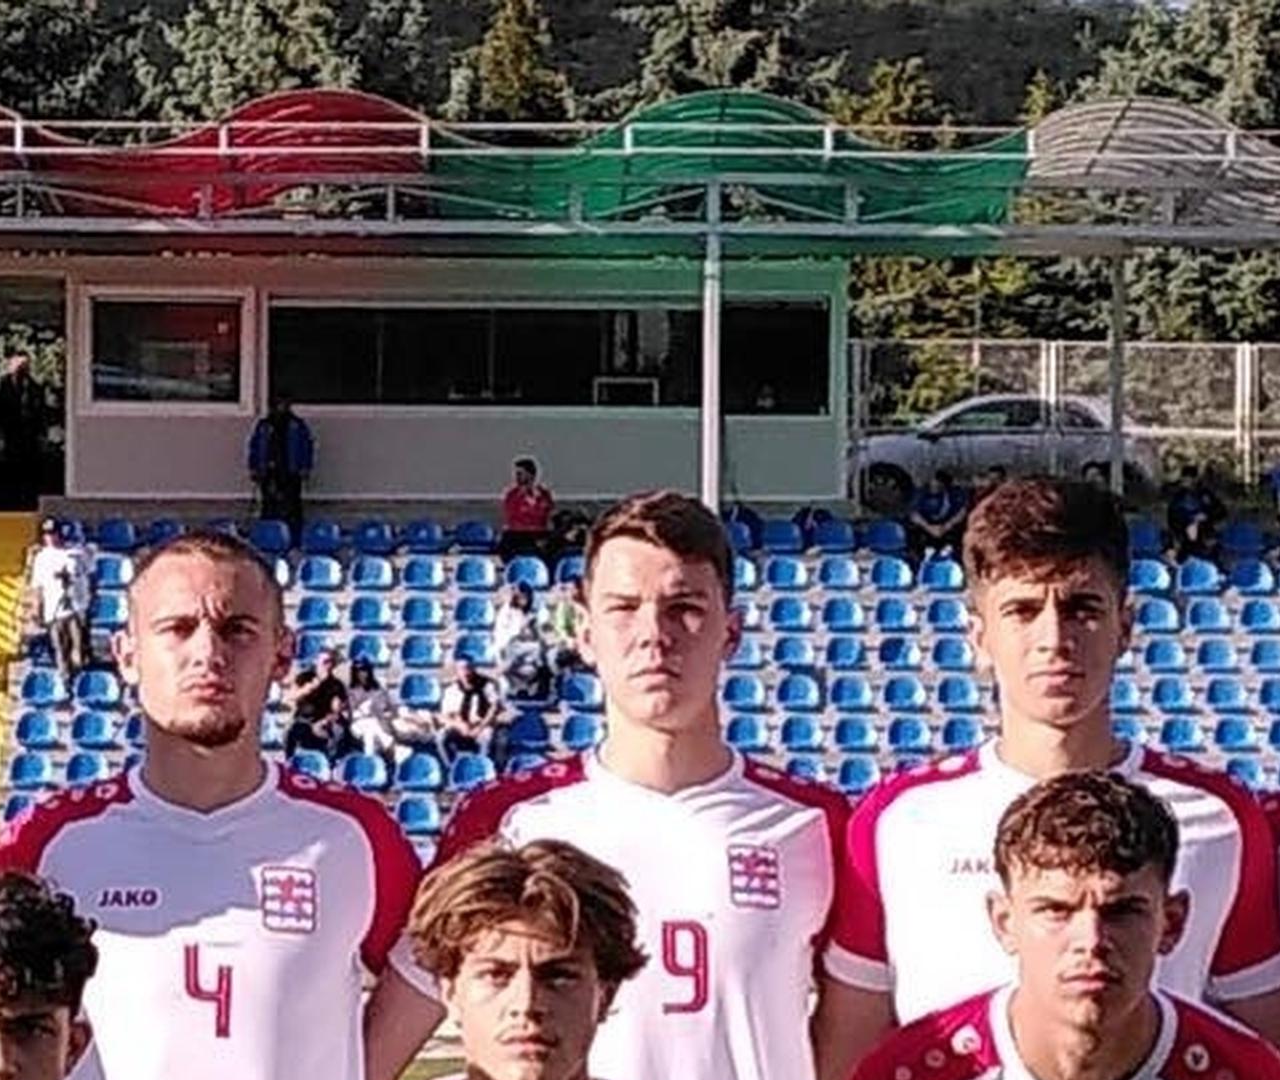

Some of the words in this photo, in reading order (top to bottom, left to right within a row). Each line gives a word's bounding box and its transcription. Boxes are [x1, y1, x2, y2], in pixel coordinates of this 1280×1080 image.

[949, 859, 992, 875] JAK
[98, 889, 158, 907] JAKO
[184, 943, 232, 1038] 4
[662, 921, 708, 1014] 9
